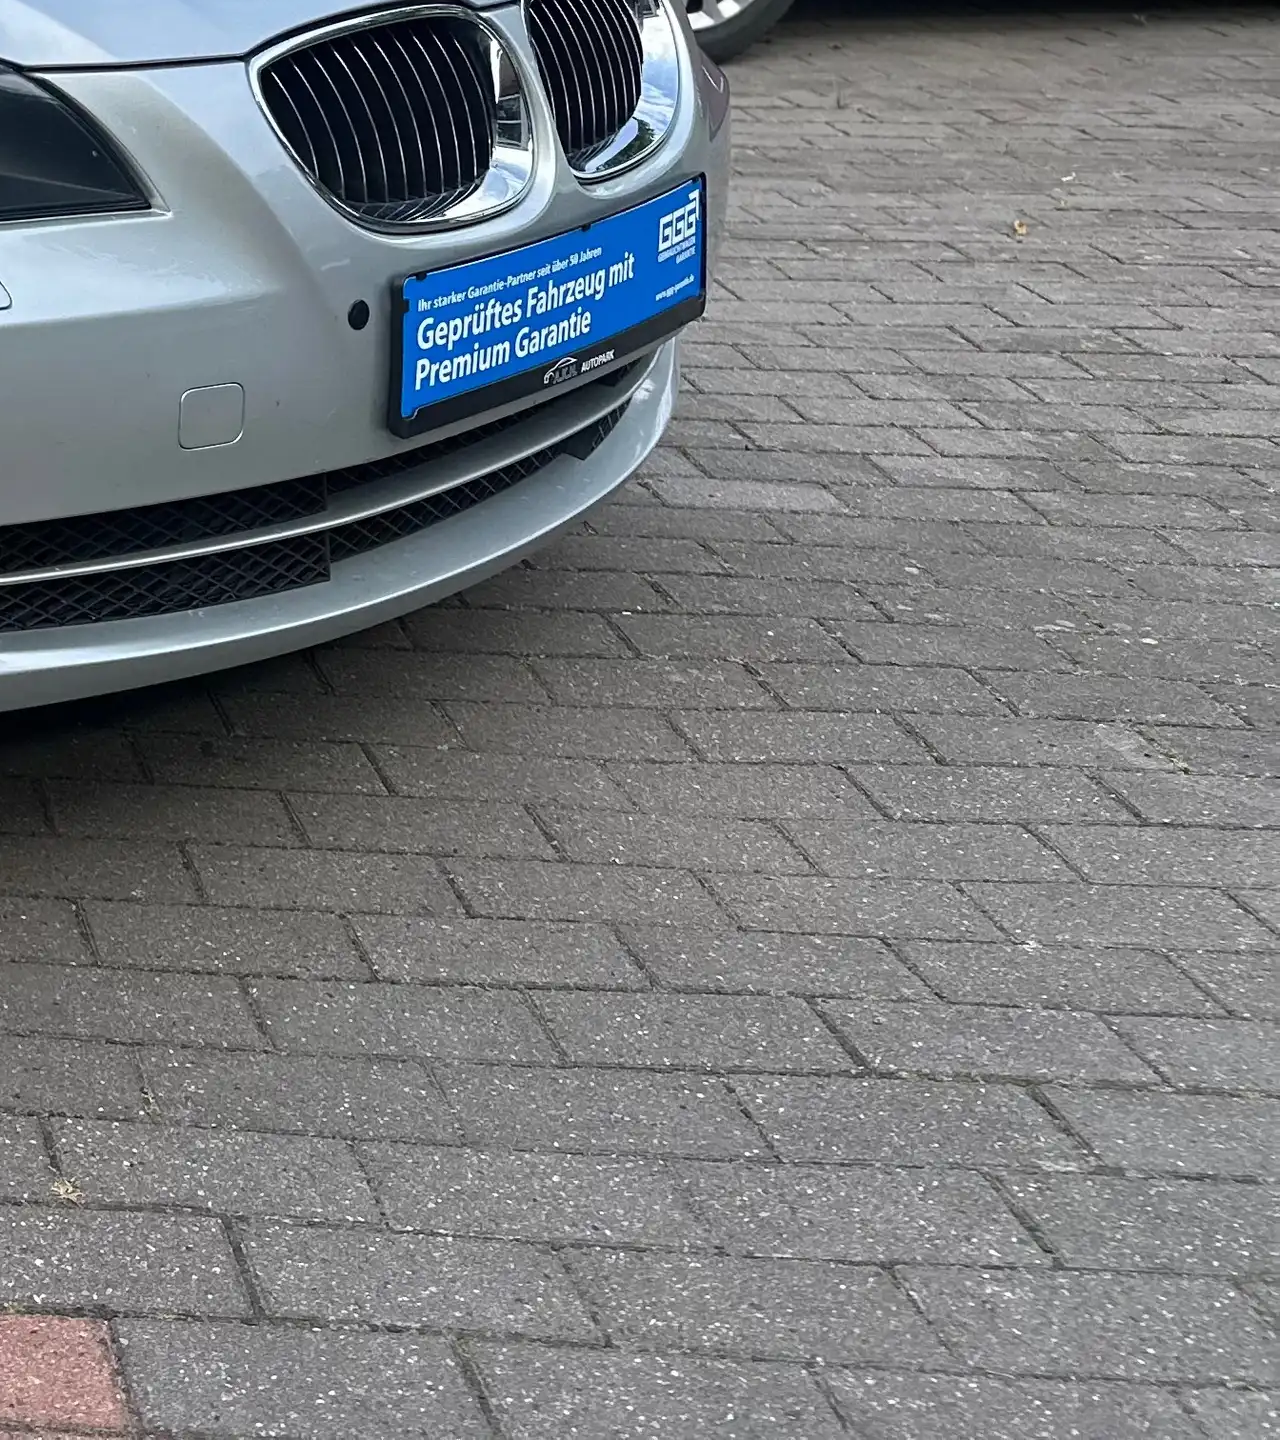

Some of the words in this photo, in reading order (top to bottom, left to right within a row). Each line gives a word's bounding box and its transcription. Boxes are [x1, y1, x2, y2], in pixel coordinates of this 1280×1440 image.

[658, 201, 697, 252] GGG
[417, 298, 522, 350] Geprüftes
[526, 268, 605, 318] Fahrzeug
[608, 251, 635, 287] mit
[418, 299, 431, 312] Ihr
[433, 291, 466, 307] starker
[467, 269, 536, 298] Garantie-Partner
[537, 263, 551, 278] seit
[552, 258, 568, 274] über
[579, 247, 602, 263] Jahren
[415, 339, 509, 391] Premium
[515, 307, 591, 358] Garantie
[580, 349, 615, 372] AUTOPARK
